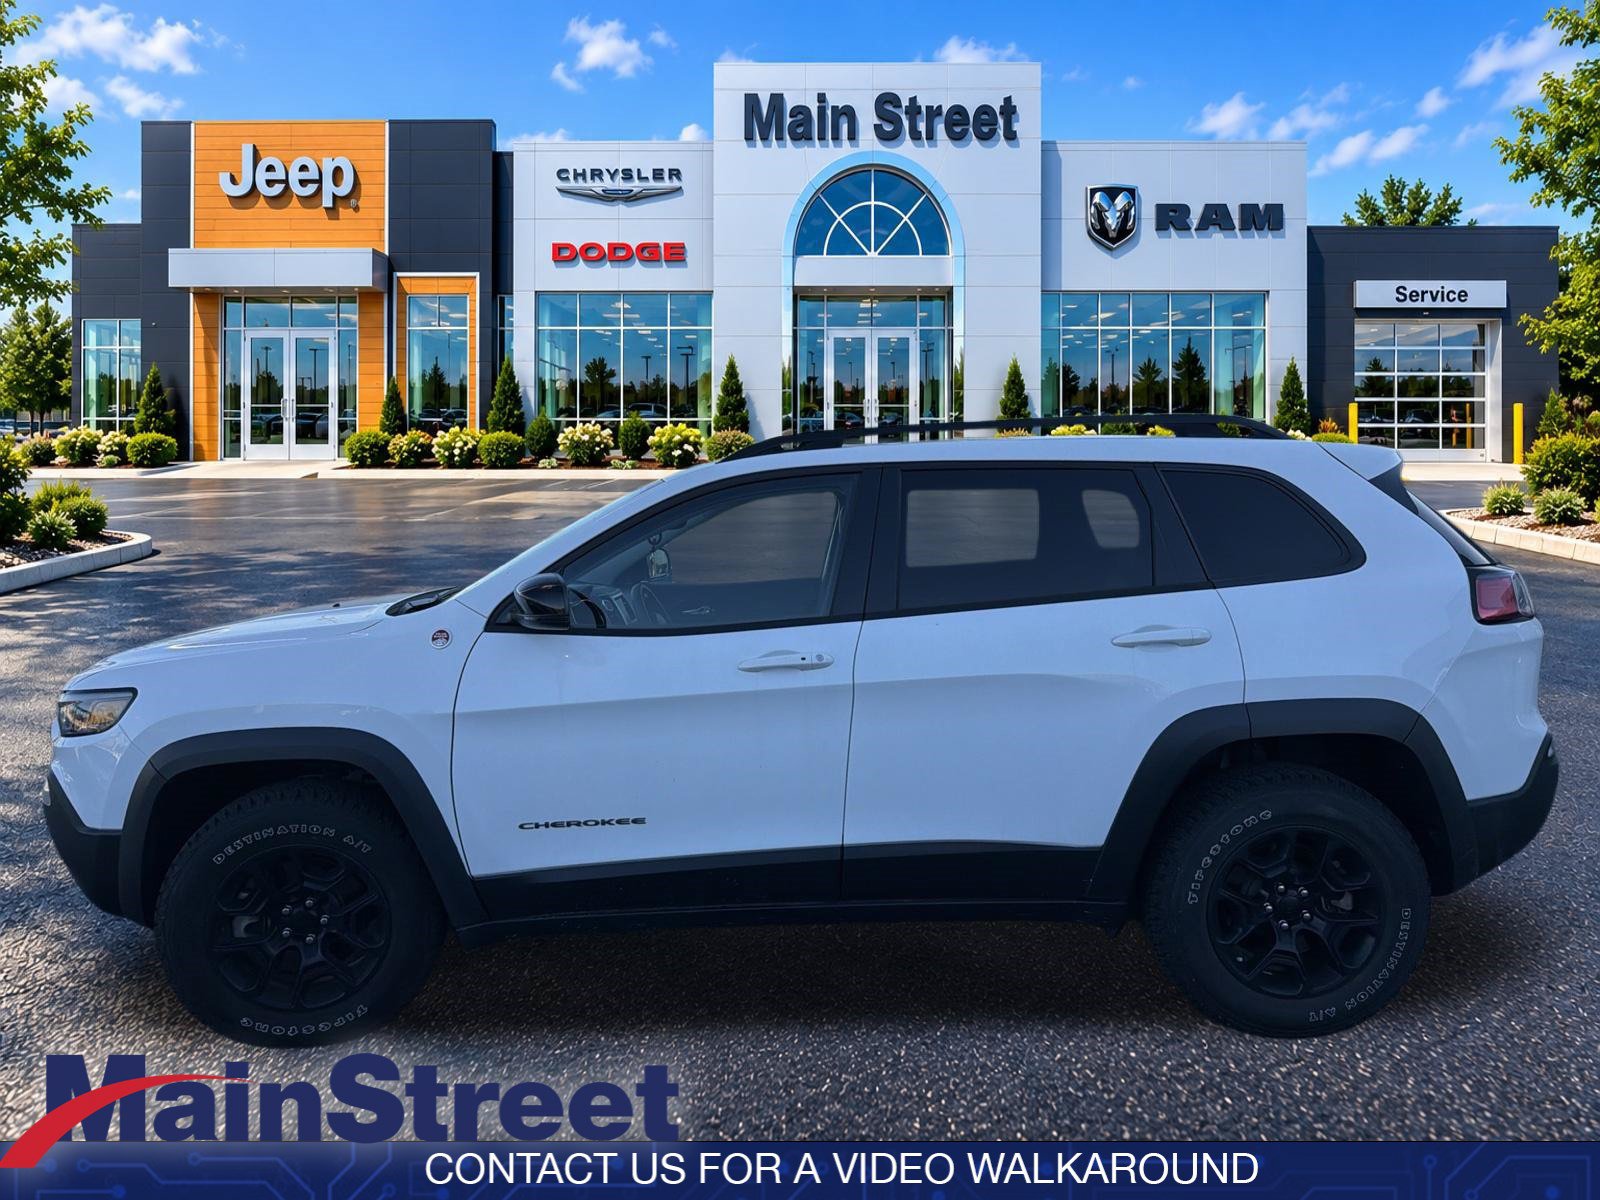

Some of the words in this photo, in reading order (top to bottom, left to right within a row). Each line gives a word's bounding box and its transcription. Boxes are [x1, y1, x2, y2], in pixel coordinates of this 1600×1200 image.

[743, 92, 857, 142] Main
[873, 91, 1018, 142] Street
[218, 143, 354, 208] Jeep
[556, 168, 682, 182] CHRYSLER
[1154, 203, 1284, 232] RAM
[551, 242, 686, 262] DODGE
[1395, 285, 1469, 303] Service
[518, 817, 647, 830] CHEROKEE
[212, 824, 337, 865] DESTINATION
[1344, 907, 1412, 1010] DESTINATION
